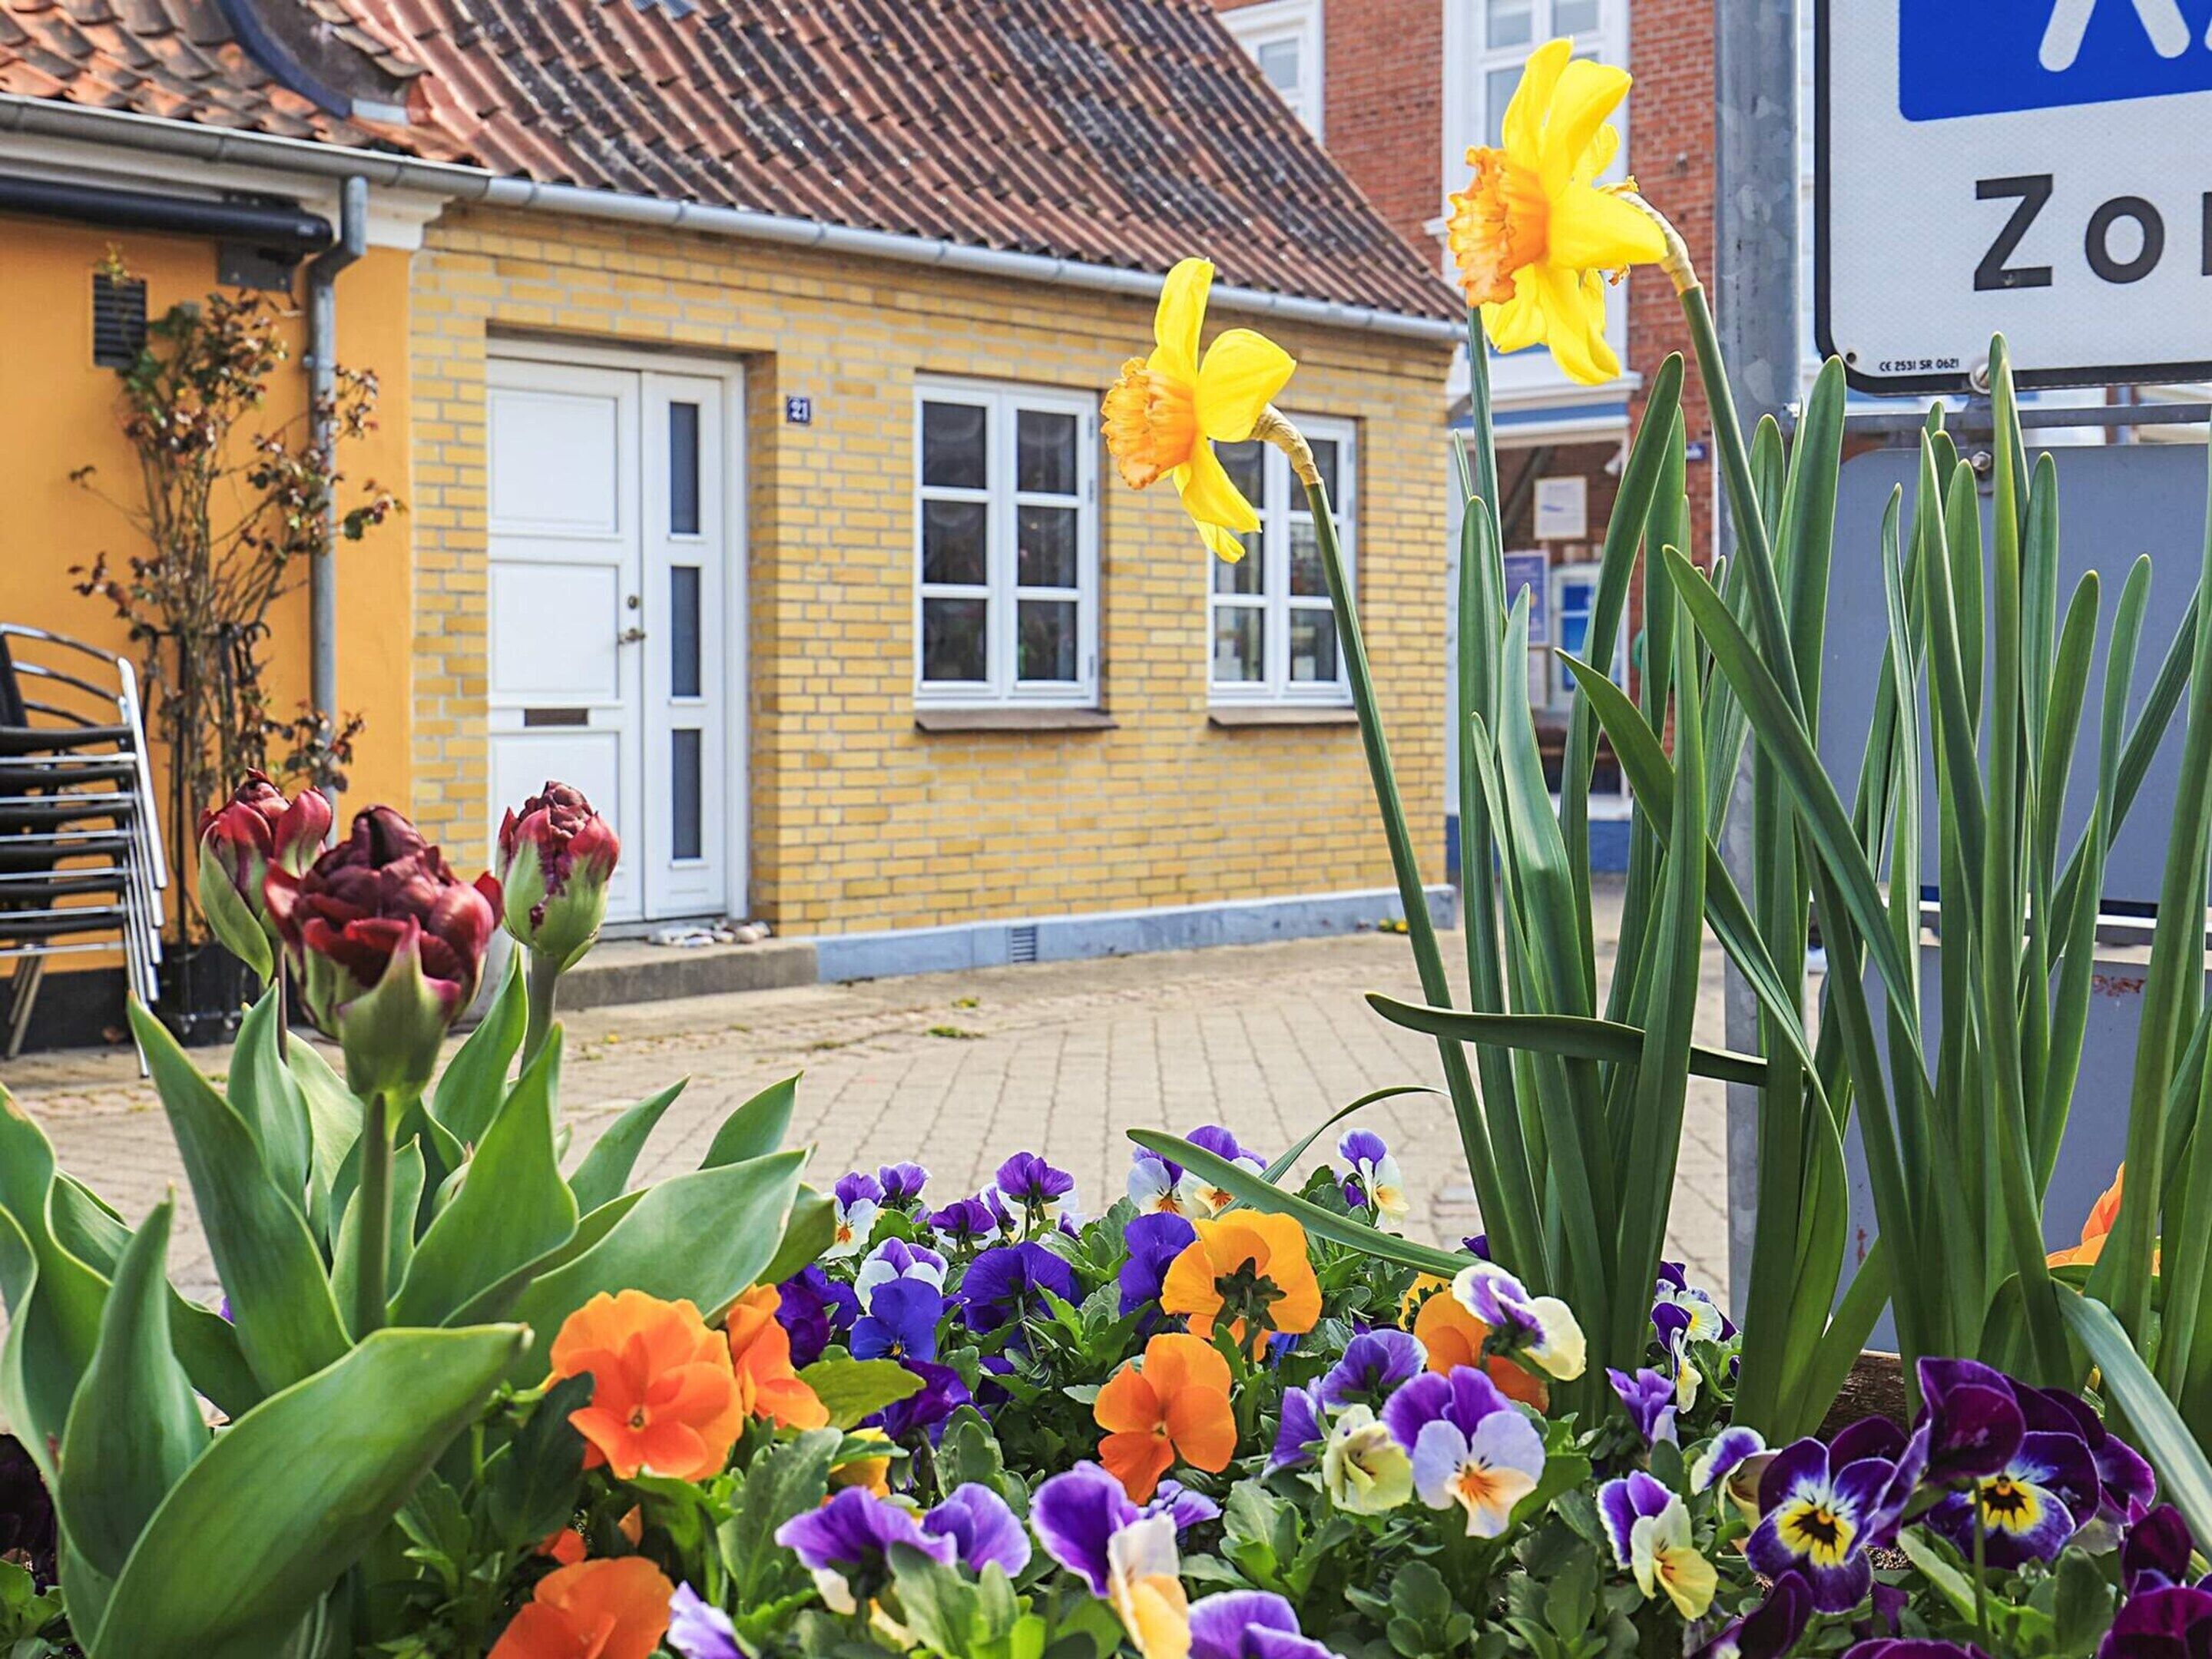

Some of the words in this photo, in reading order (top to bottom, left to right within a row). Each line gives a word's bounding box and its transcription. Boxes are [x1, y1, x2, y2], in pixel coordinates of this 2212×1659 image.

[1974, 174, 2212, 291] Zo
[1894, 360, 1916, 371] 2531
[1919, 359, 1933, 369] SR
[1936, 358, 1959, 369] 0621
[791, 400, 808, 421] 21
